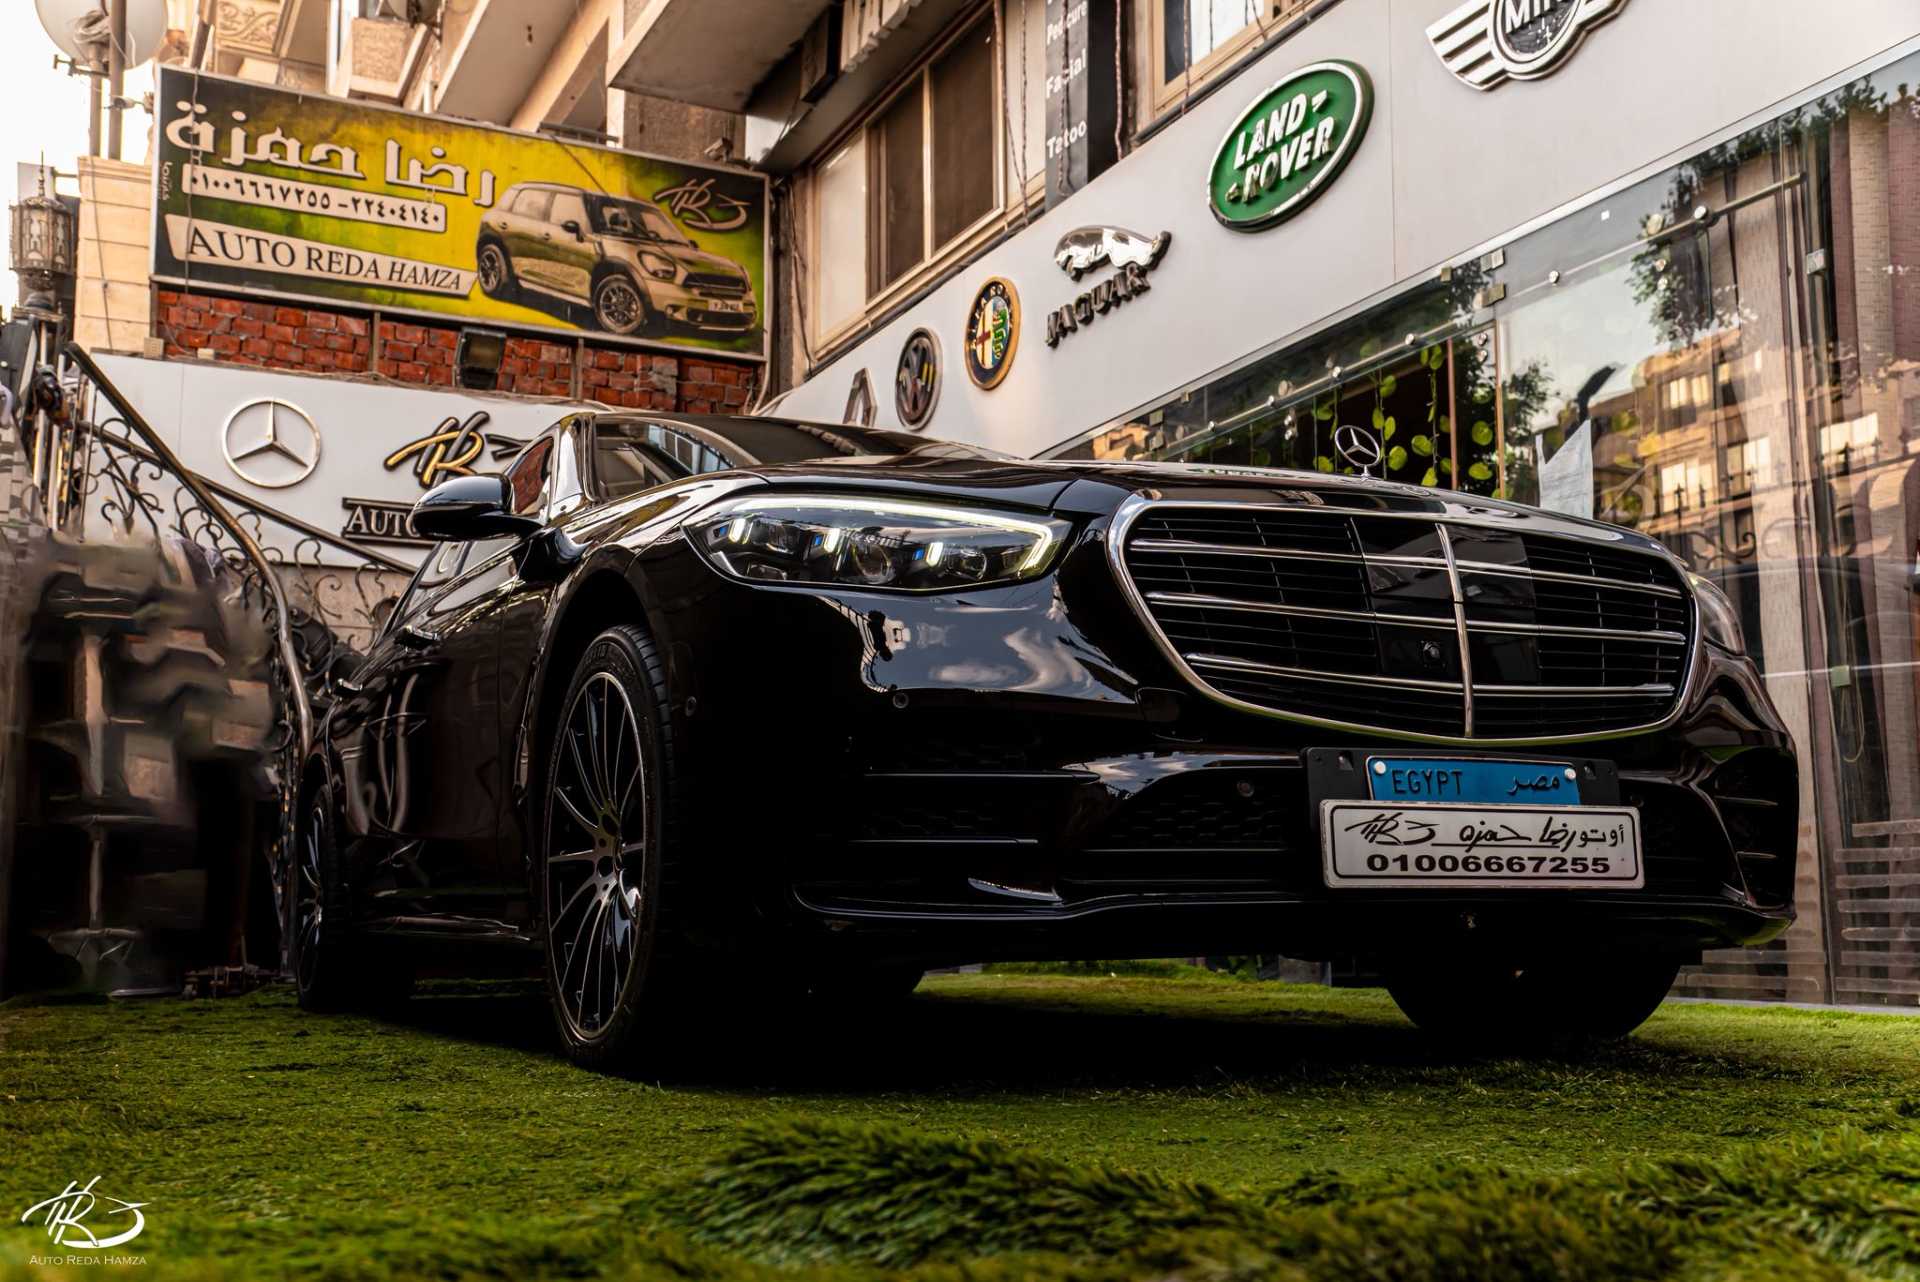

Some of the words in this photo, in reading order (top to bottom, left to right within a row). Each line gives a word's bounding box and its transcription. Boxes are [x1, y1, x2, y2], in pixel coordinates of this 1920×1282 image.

[1047, 1, 1087, 45] Pedcure
[166, 100, 367, 179] حمزة
[1047, 120, 1087, 159] Tatoo
[386, 139, 495, 207] رضا
[189, 227, 295, 267] AUTO
[306, 246, 380, 279] REDA
[388, 261, 461, 290] HAMZA
[1392, 769, 1464, 796] EGYPT
[1507, 775, 1561, 796] مصر
[1367, 854, 1610, 873] 01006667255
